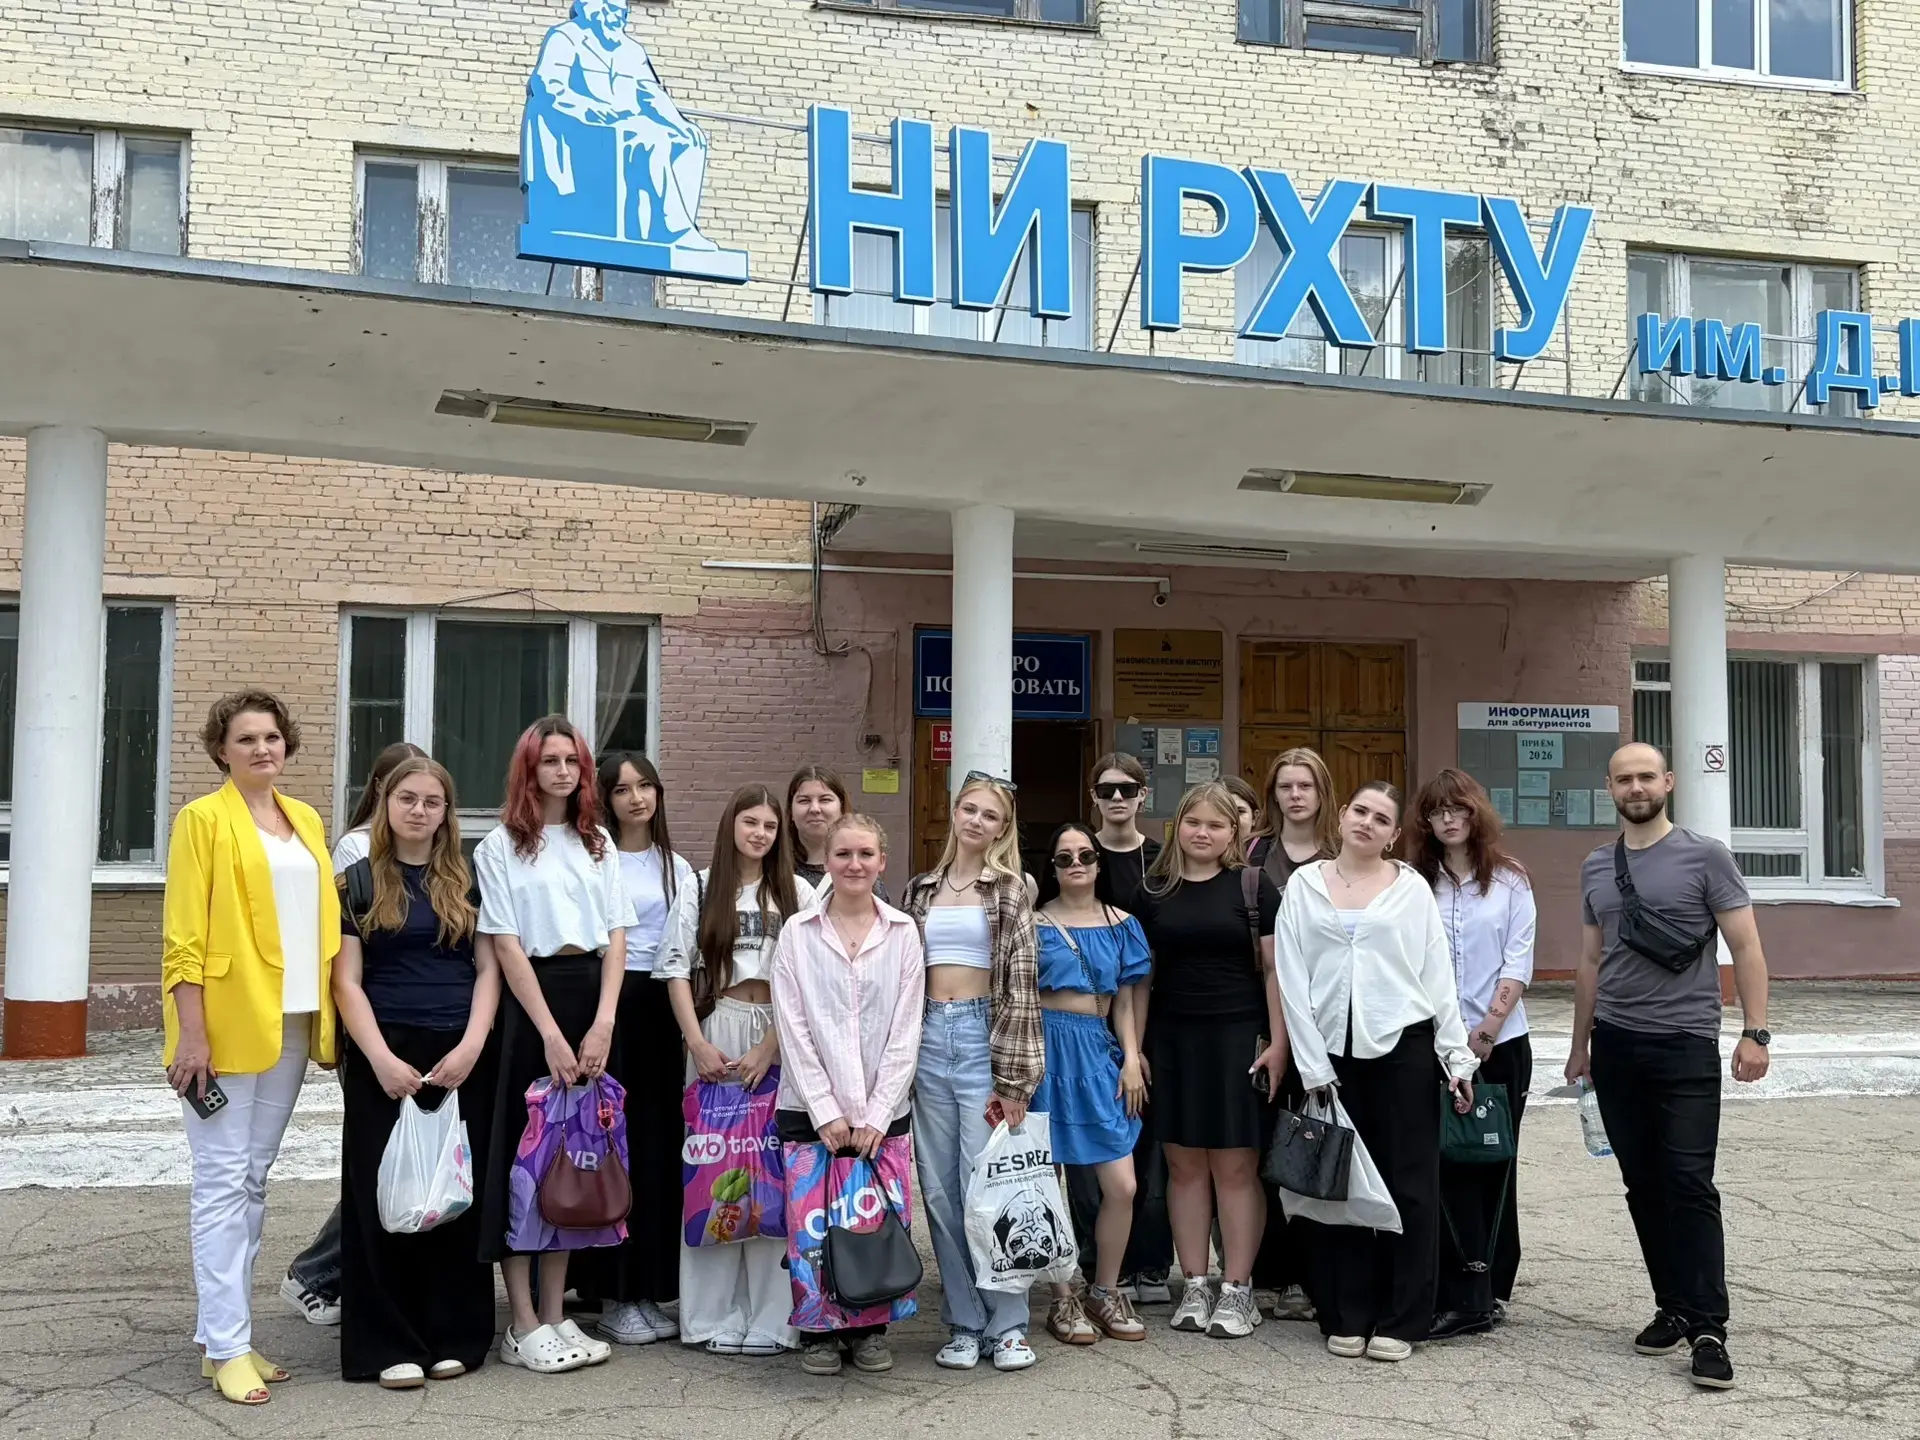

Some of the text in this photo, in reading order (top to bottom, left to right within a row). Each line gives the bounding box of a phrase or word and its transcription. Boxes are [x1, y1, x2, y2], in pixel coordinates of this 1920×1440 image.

[807, 103, 1073, 320] НИ
[1141, 152, 1596, 364] РХТУ
[925, 676, 1081, 696] ПООВАТЬ
[1488, 706, 1590, 719] ИНФОРМАЦИЯ
[1487, 719, 1591, 730] для абитуриентов
[1529, 751, 1553, 760] 2026
[687, 1134, 782, 1158] wb trave
[805, 1179, 904, 1241] OZON
